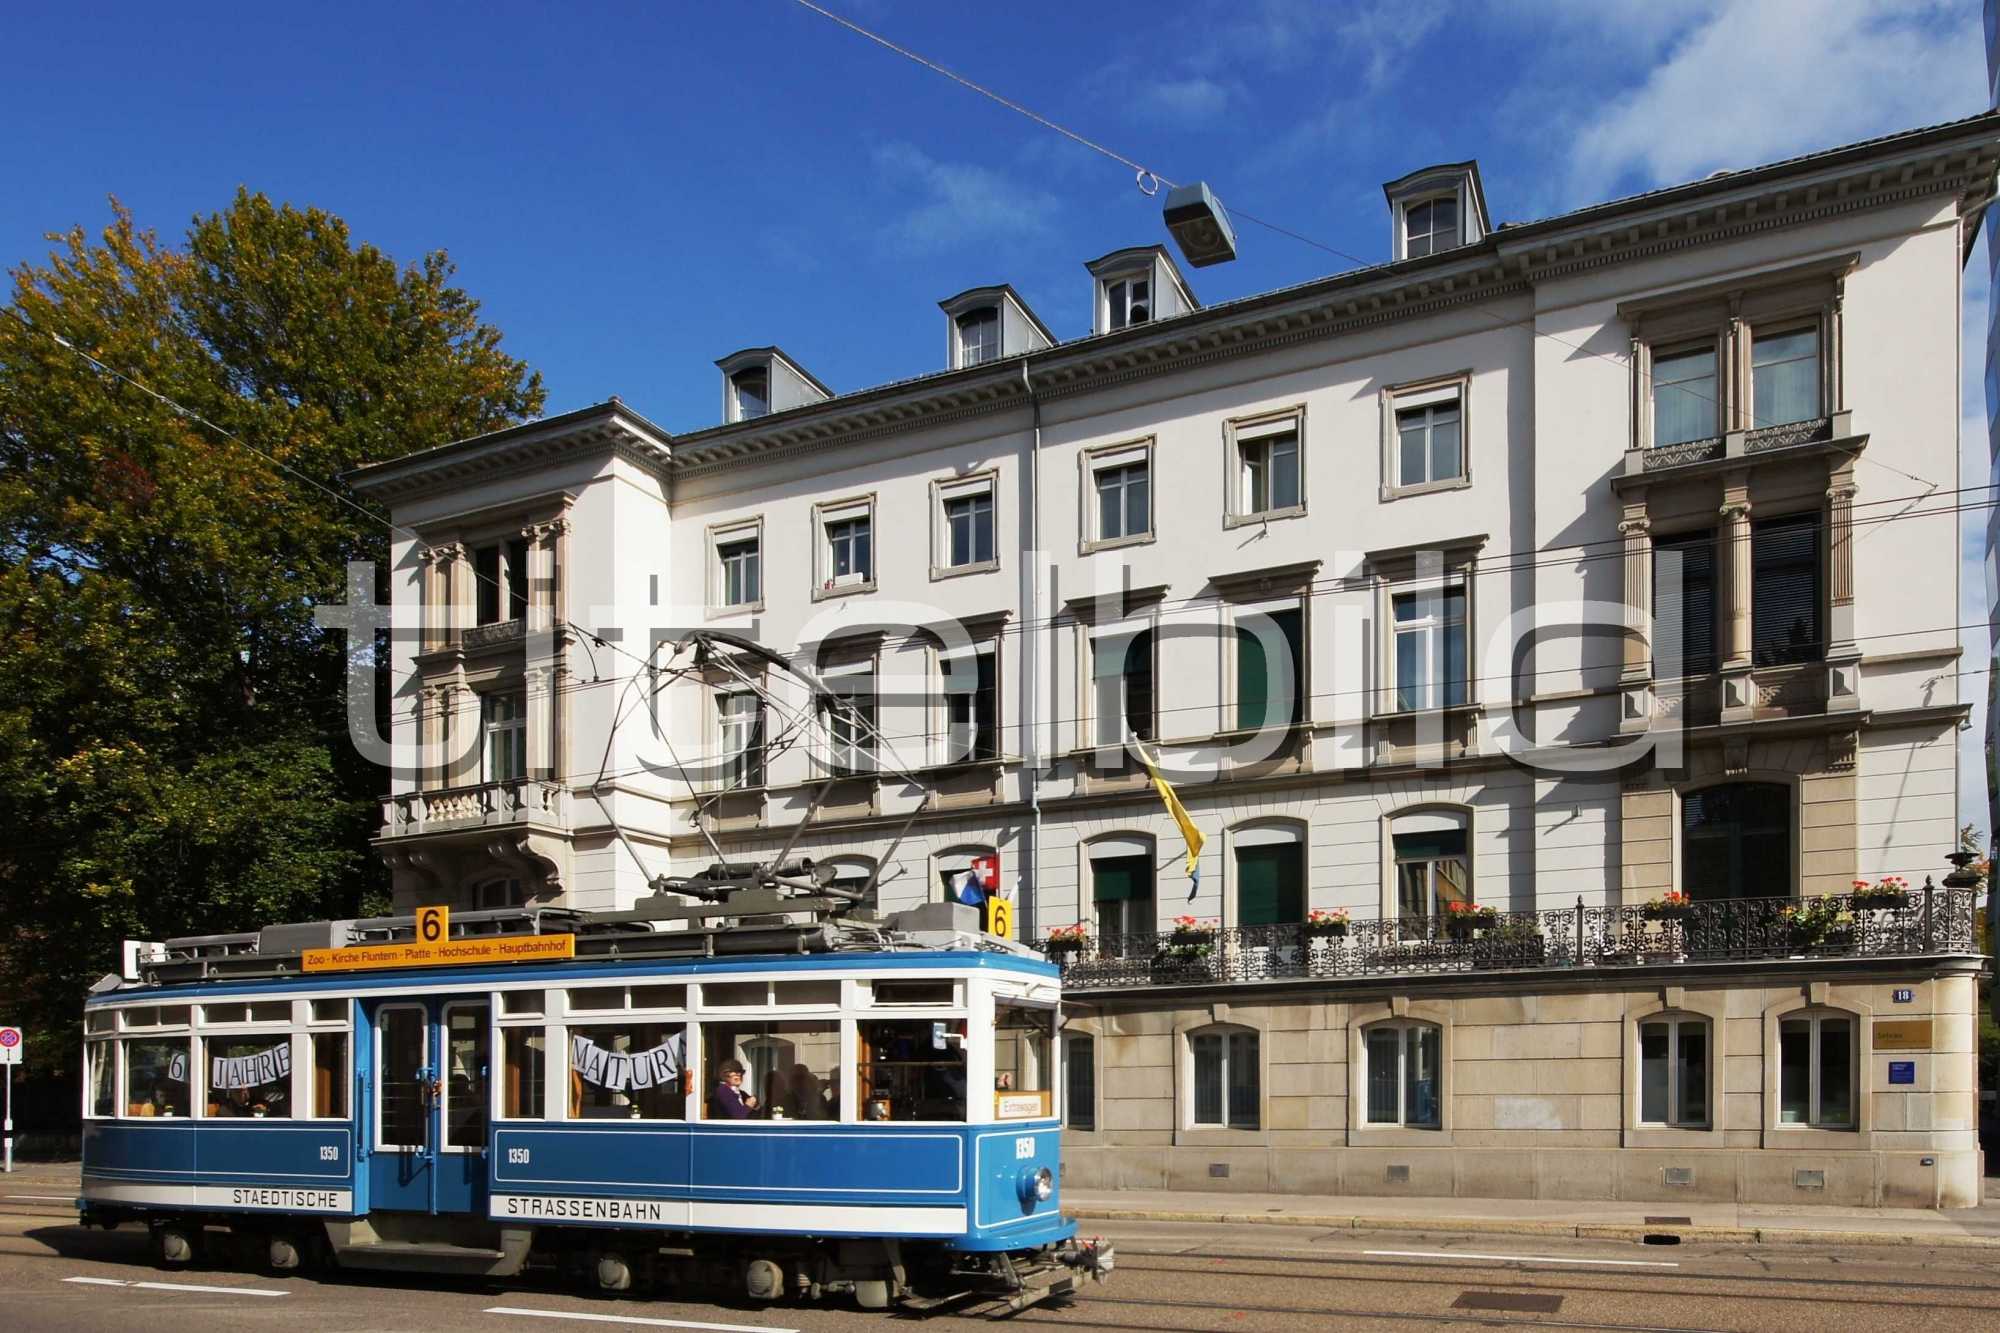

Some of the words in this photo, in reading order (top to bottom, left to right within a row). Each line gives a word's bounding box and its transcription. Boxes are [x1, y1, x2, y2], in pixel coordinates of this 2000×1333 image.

[422, 909, 441, 942] 6
[995, 905, 1006, 938] 6
[307, 954, 325, 965] Zoo
[331, 952, 359, 963] Kirche
[361, 950, 398, 962] Fluntern
[405, 948, 431, 960] Platte
[439, 944, 491, 957] Hochschule
[500, 940, 566, 955] Hauptbahnhof
[1898, 991, 1909, 1001] 18
[214, 1046, 289, 1087] JAHRE
[320, 1146, 339, 1161] 1350
[508, 1148, 530, 1164] 1350
[1016, 1136, 1036, 1160] 1350
[233, 1189, 338, 1208] STAEDTISCHE
[508, 1198, 661, 1220] STRASSENBAHN
